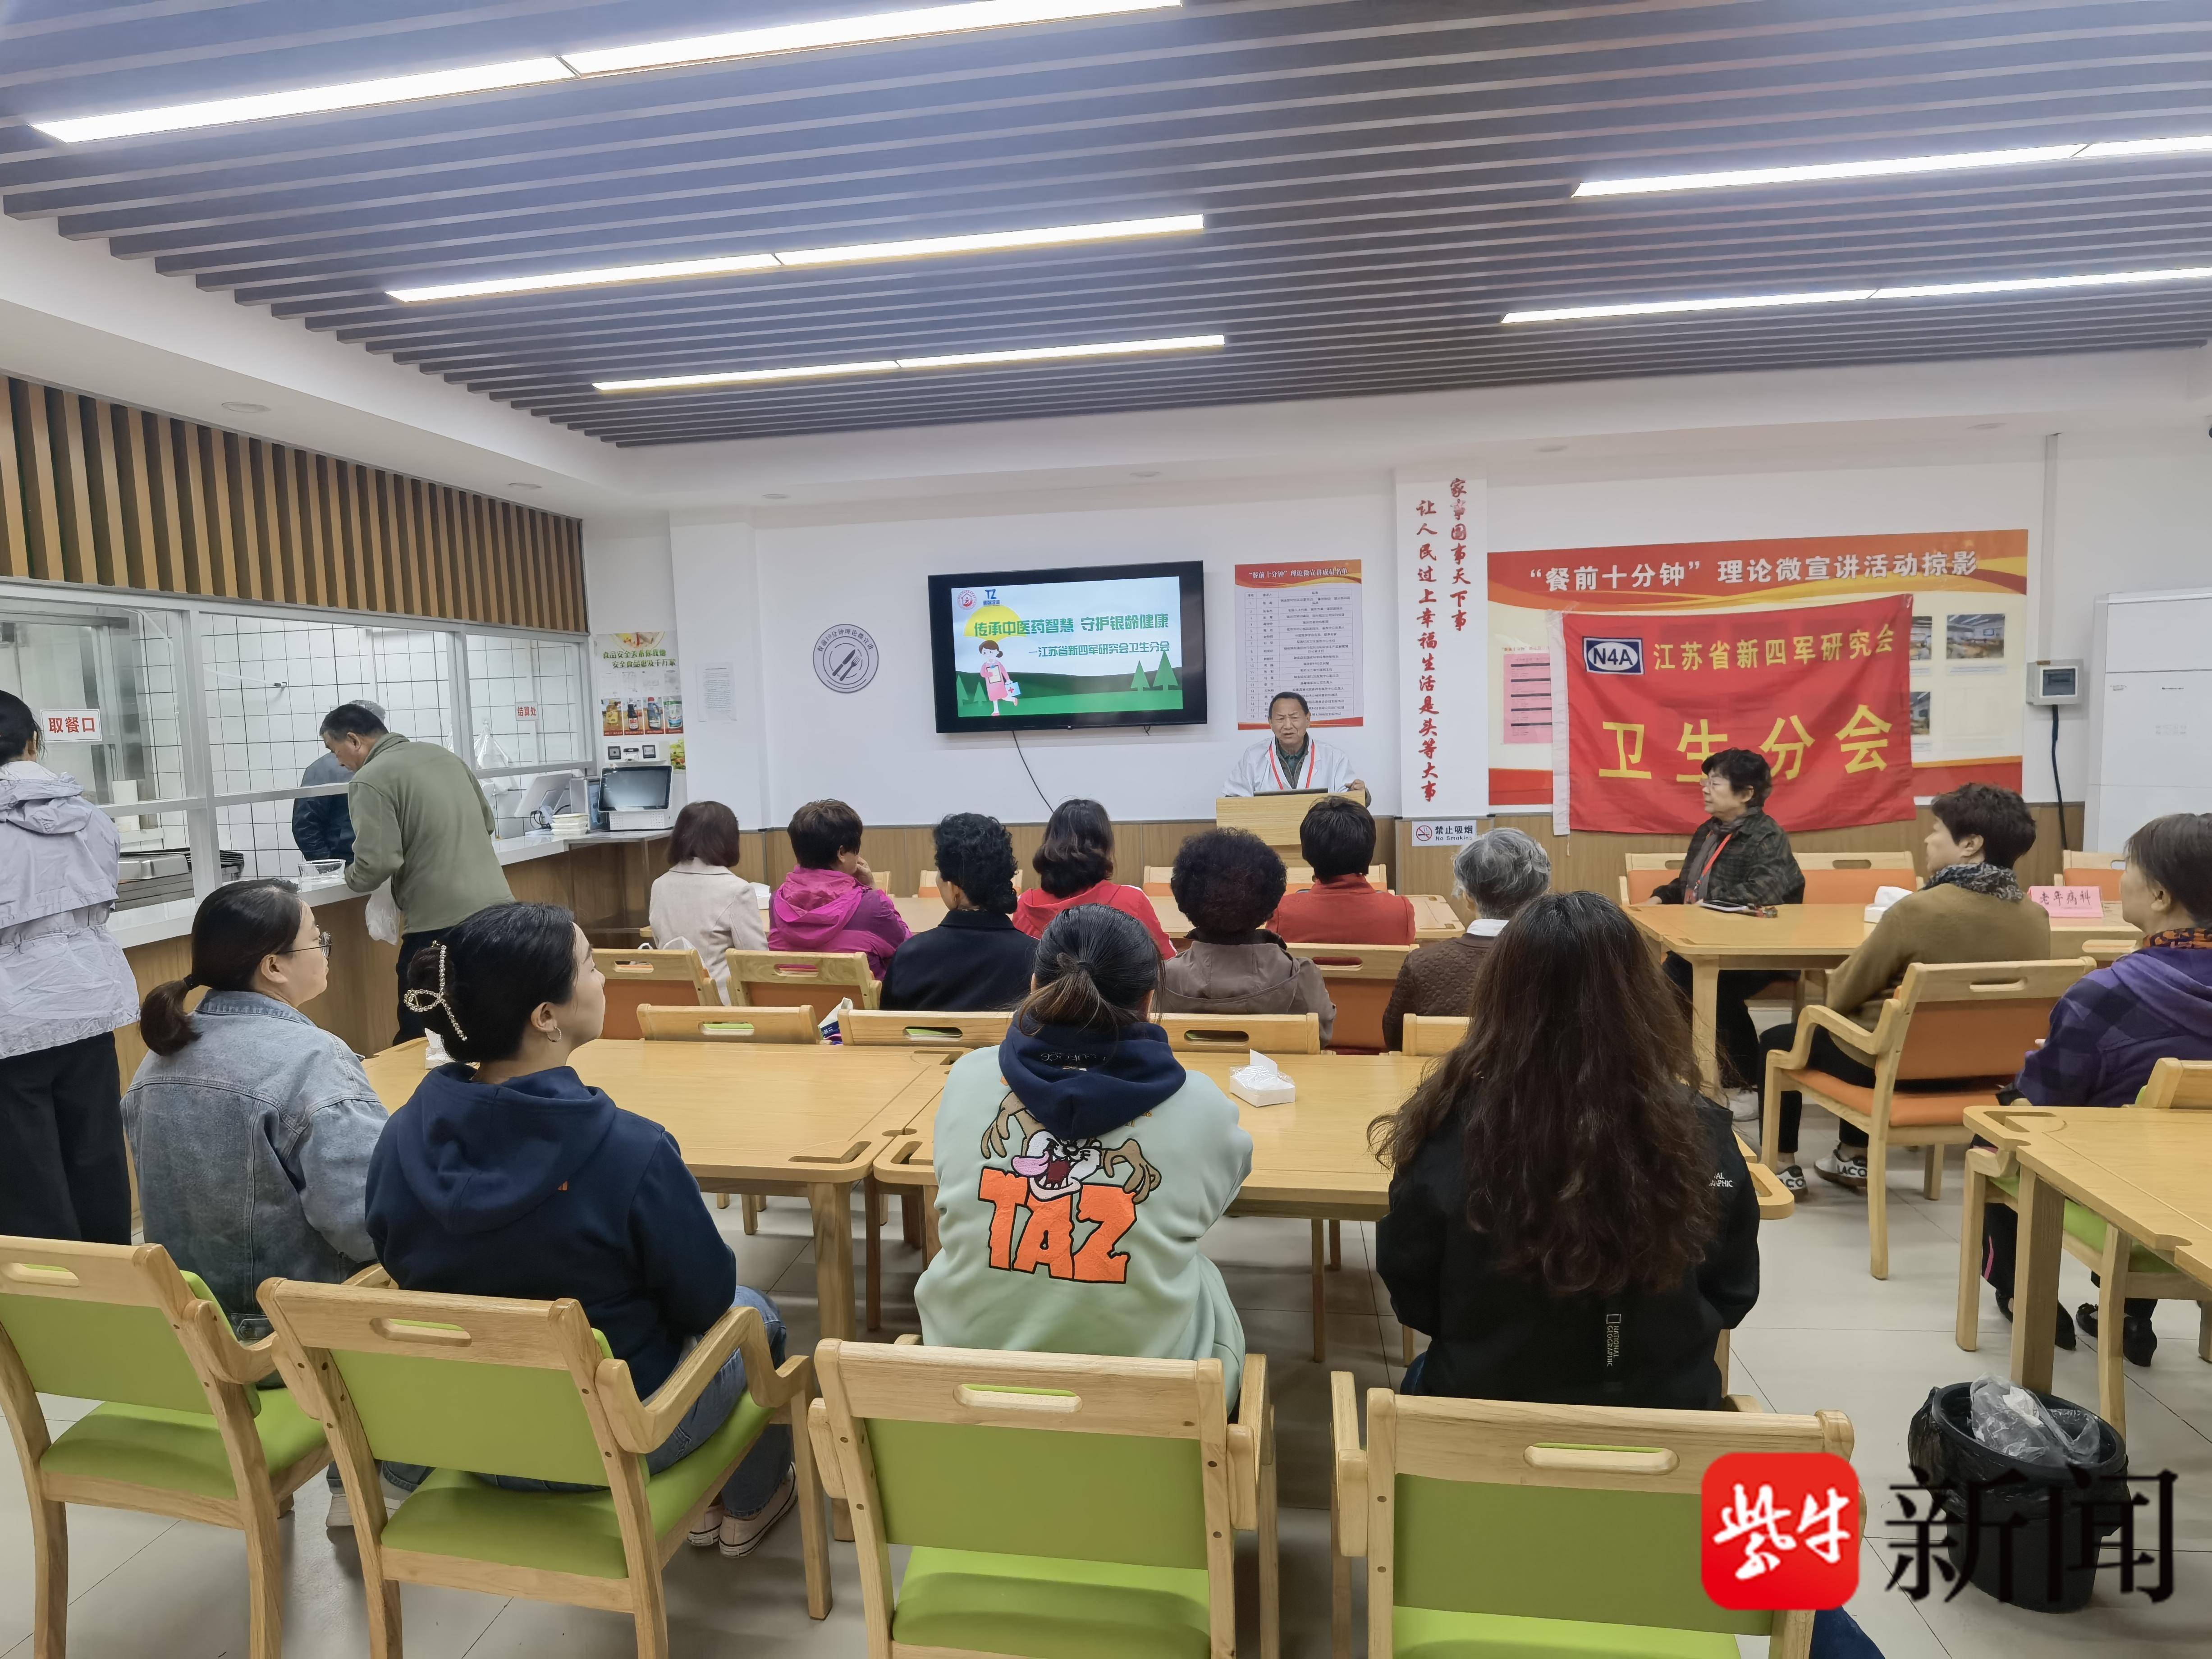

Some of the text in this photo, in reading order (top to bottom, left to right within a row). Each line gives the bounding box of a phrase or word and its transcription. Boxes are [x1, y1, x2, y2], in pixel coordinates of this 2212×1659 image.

[1530, 550, 1978, 592] “餐前十分钟” 理论微宣讲活动掠影
[974, 613, 1168, 637] 传承中医药智慧 守护银龄健康
[1416, 500, 1439, 802] 让人民过上幸福生活是头等大事
[1593, 647, 1634, 666] N4A
[1653, 623, 1895, 671] 江苏省新四军研究会
[49, 717, 96, 733] 取餐口
[1598, 704, 1892, 783] 卫生分会
[1435, 825, 1473, 834] 禁止吸烟
[977, 1166, 1138, 1284] TAZ
